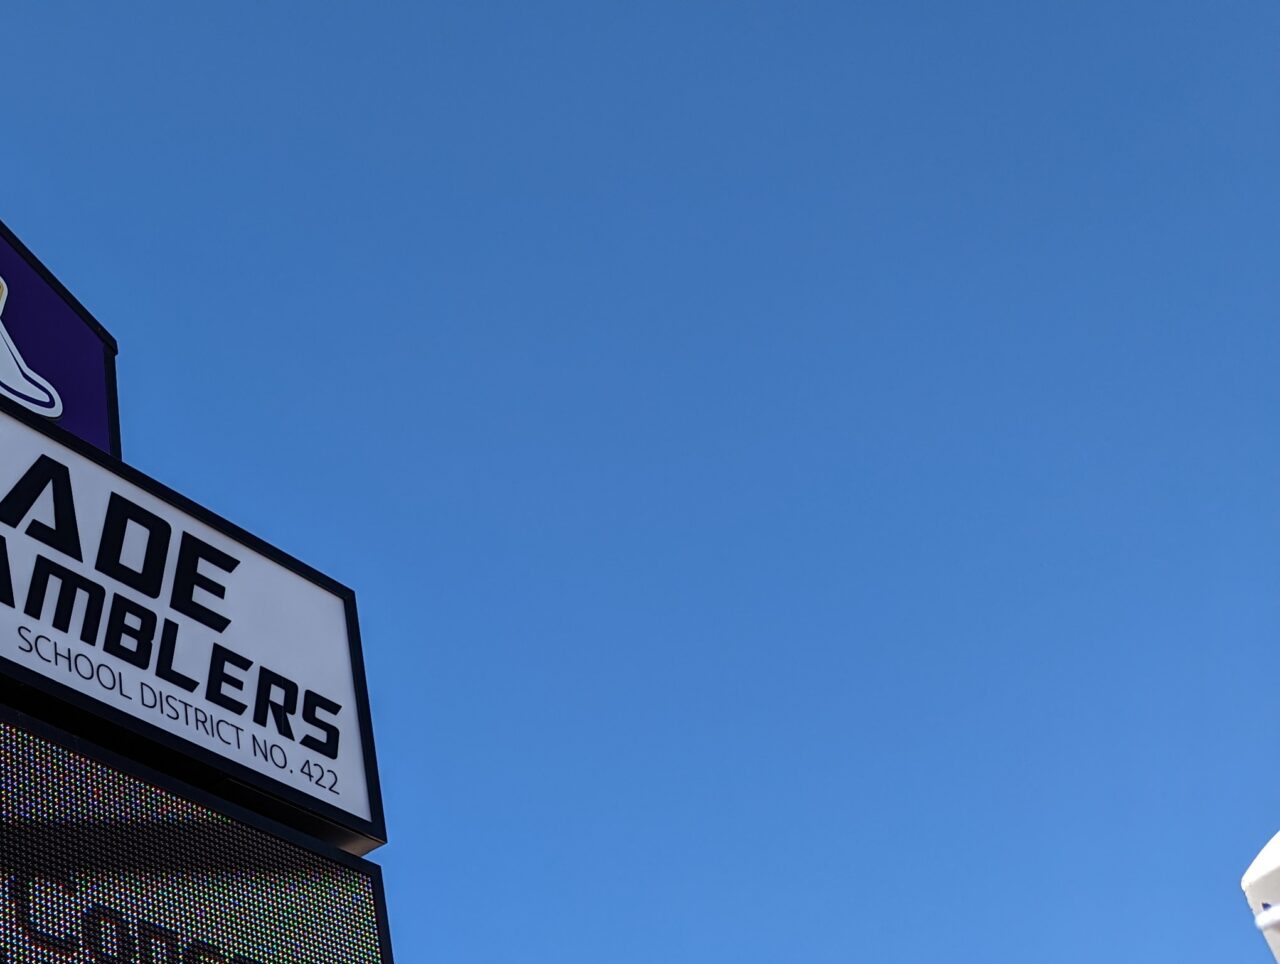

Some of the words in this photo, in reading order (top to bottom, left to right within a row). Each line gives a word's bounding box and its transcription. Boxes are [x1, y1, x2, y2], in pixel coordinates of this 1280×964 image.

[17, 625, 133, 701] SCHOOL
[140, 681, 244, 749] DISTRICT
[252, 733, 294, 774] NO.
[299, 759, 341, 796] 422
